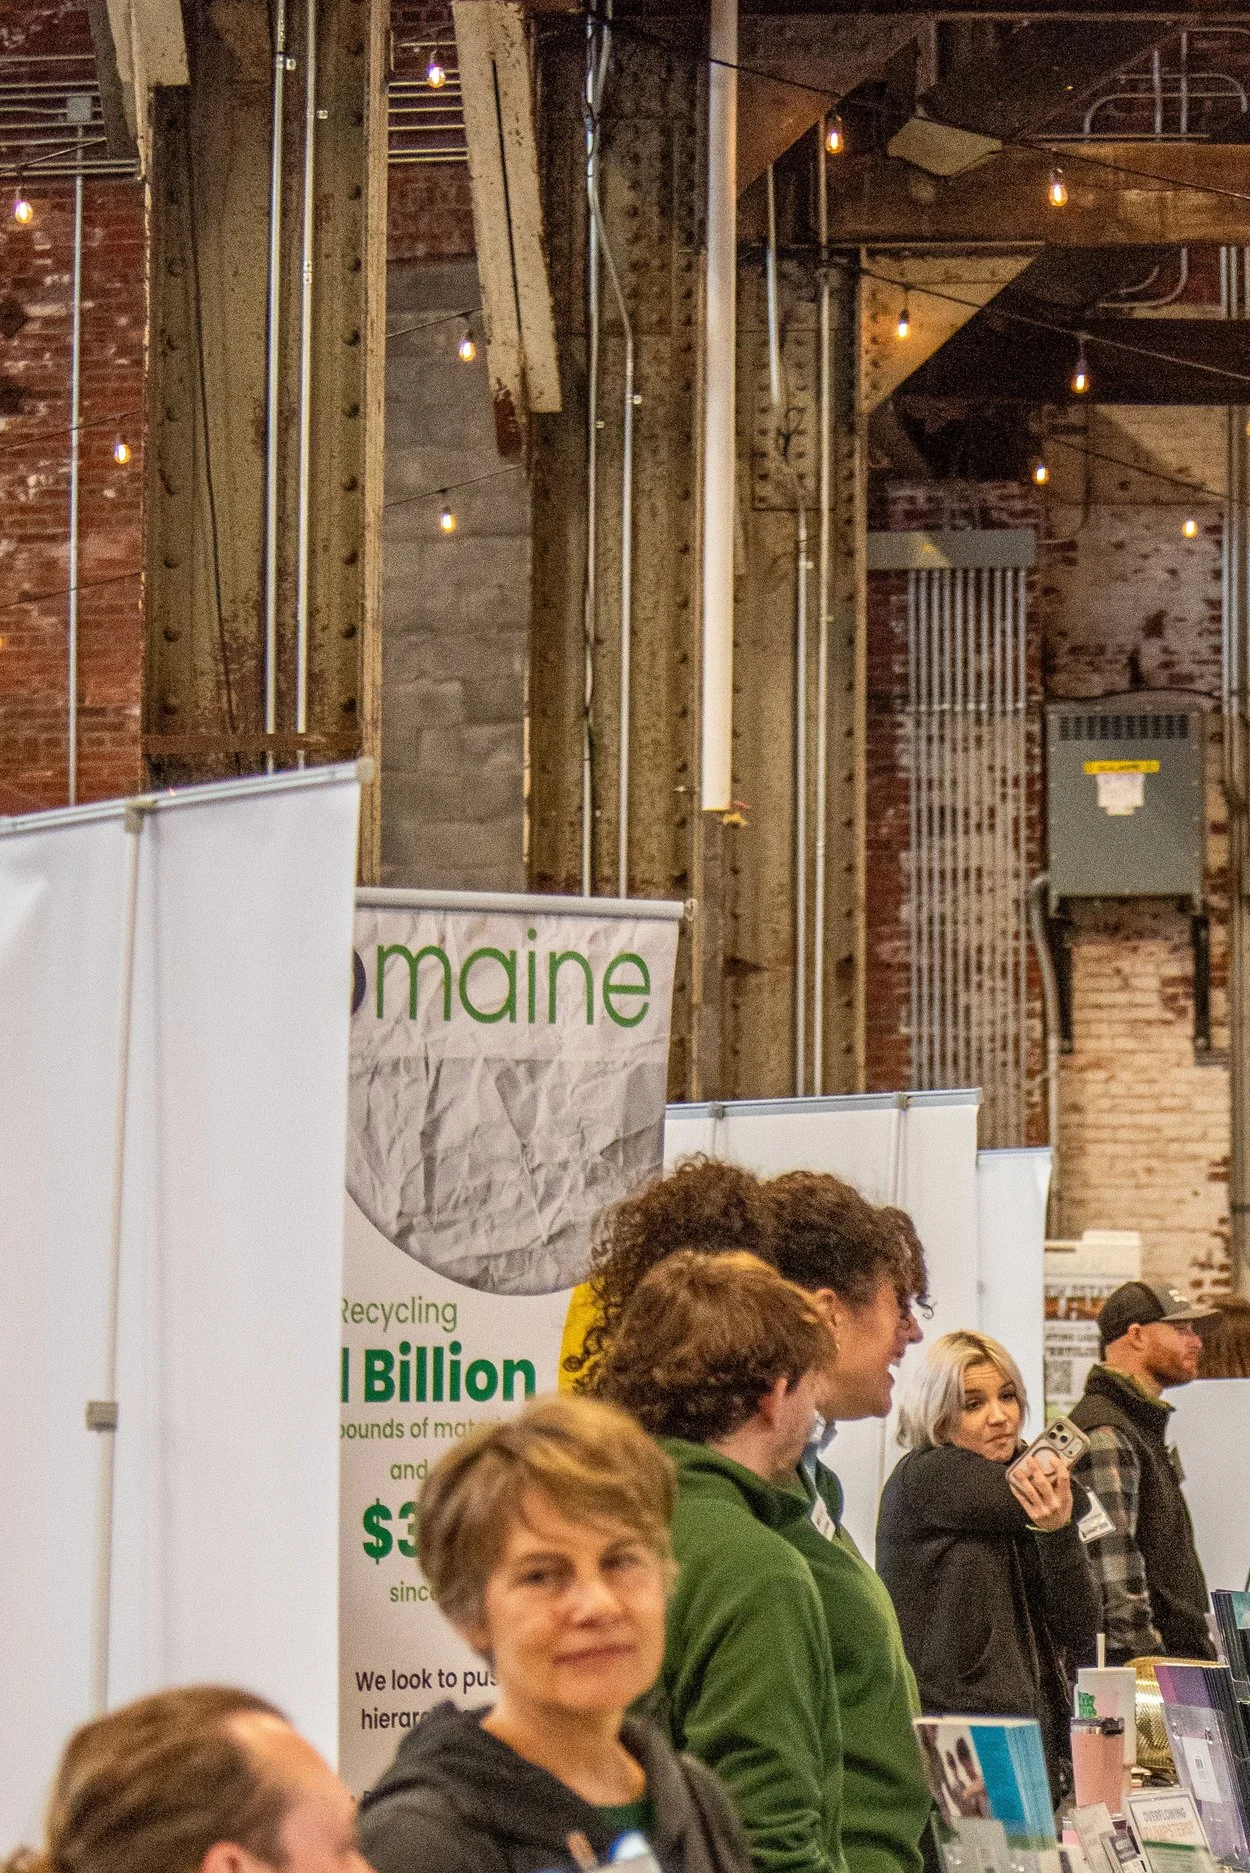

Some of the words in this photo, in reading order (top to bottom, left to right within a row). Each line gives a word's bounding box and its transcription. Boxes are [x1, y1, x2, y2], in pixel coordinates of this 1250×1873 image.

[376, 928, 651, 1028] maine
[365, 1341, 536, 1402] Billion
[410, 1417, 428, 1438] of
[390, 1459, 428, 1480] and
[356, 1671, 386, 1691] We
[392, 1668, 432, 1690] look
[438, 1669, 457, 1688] to
